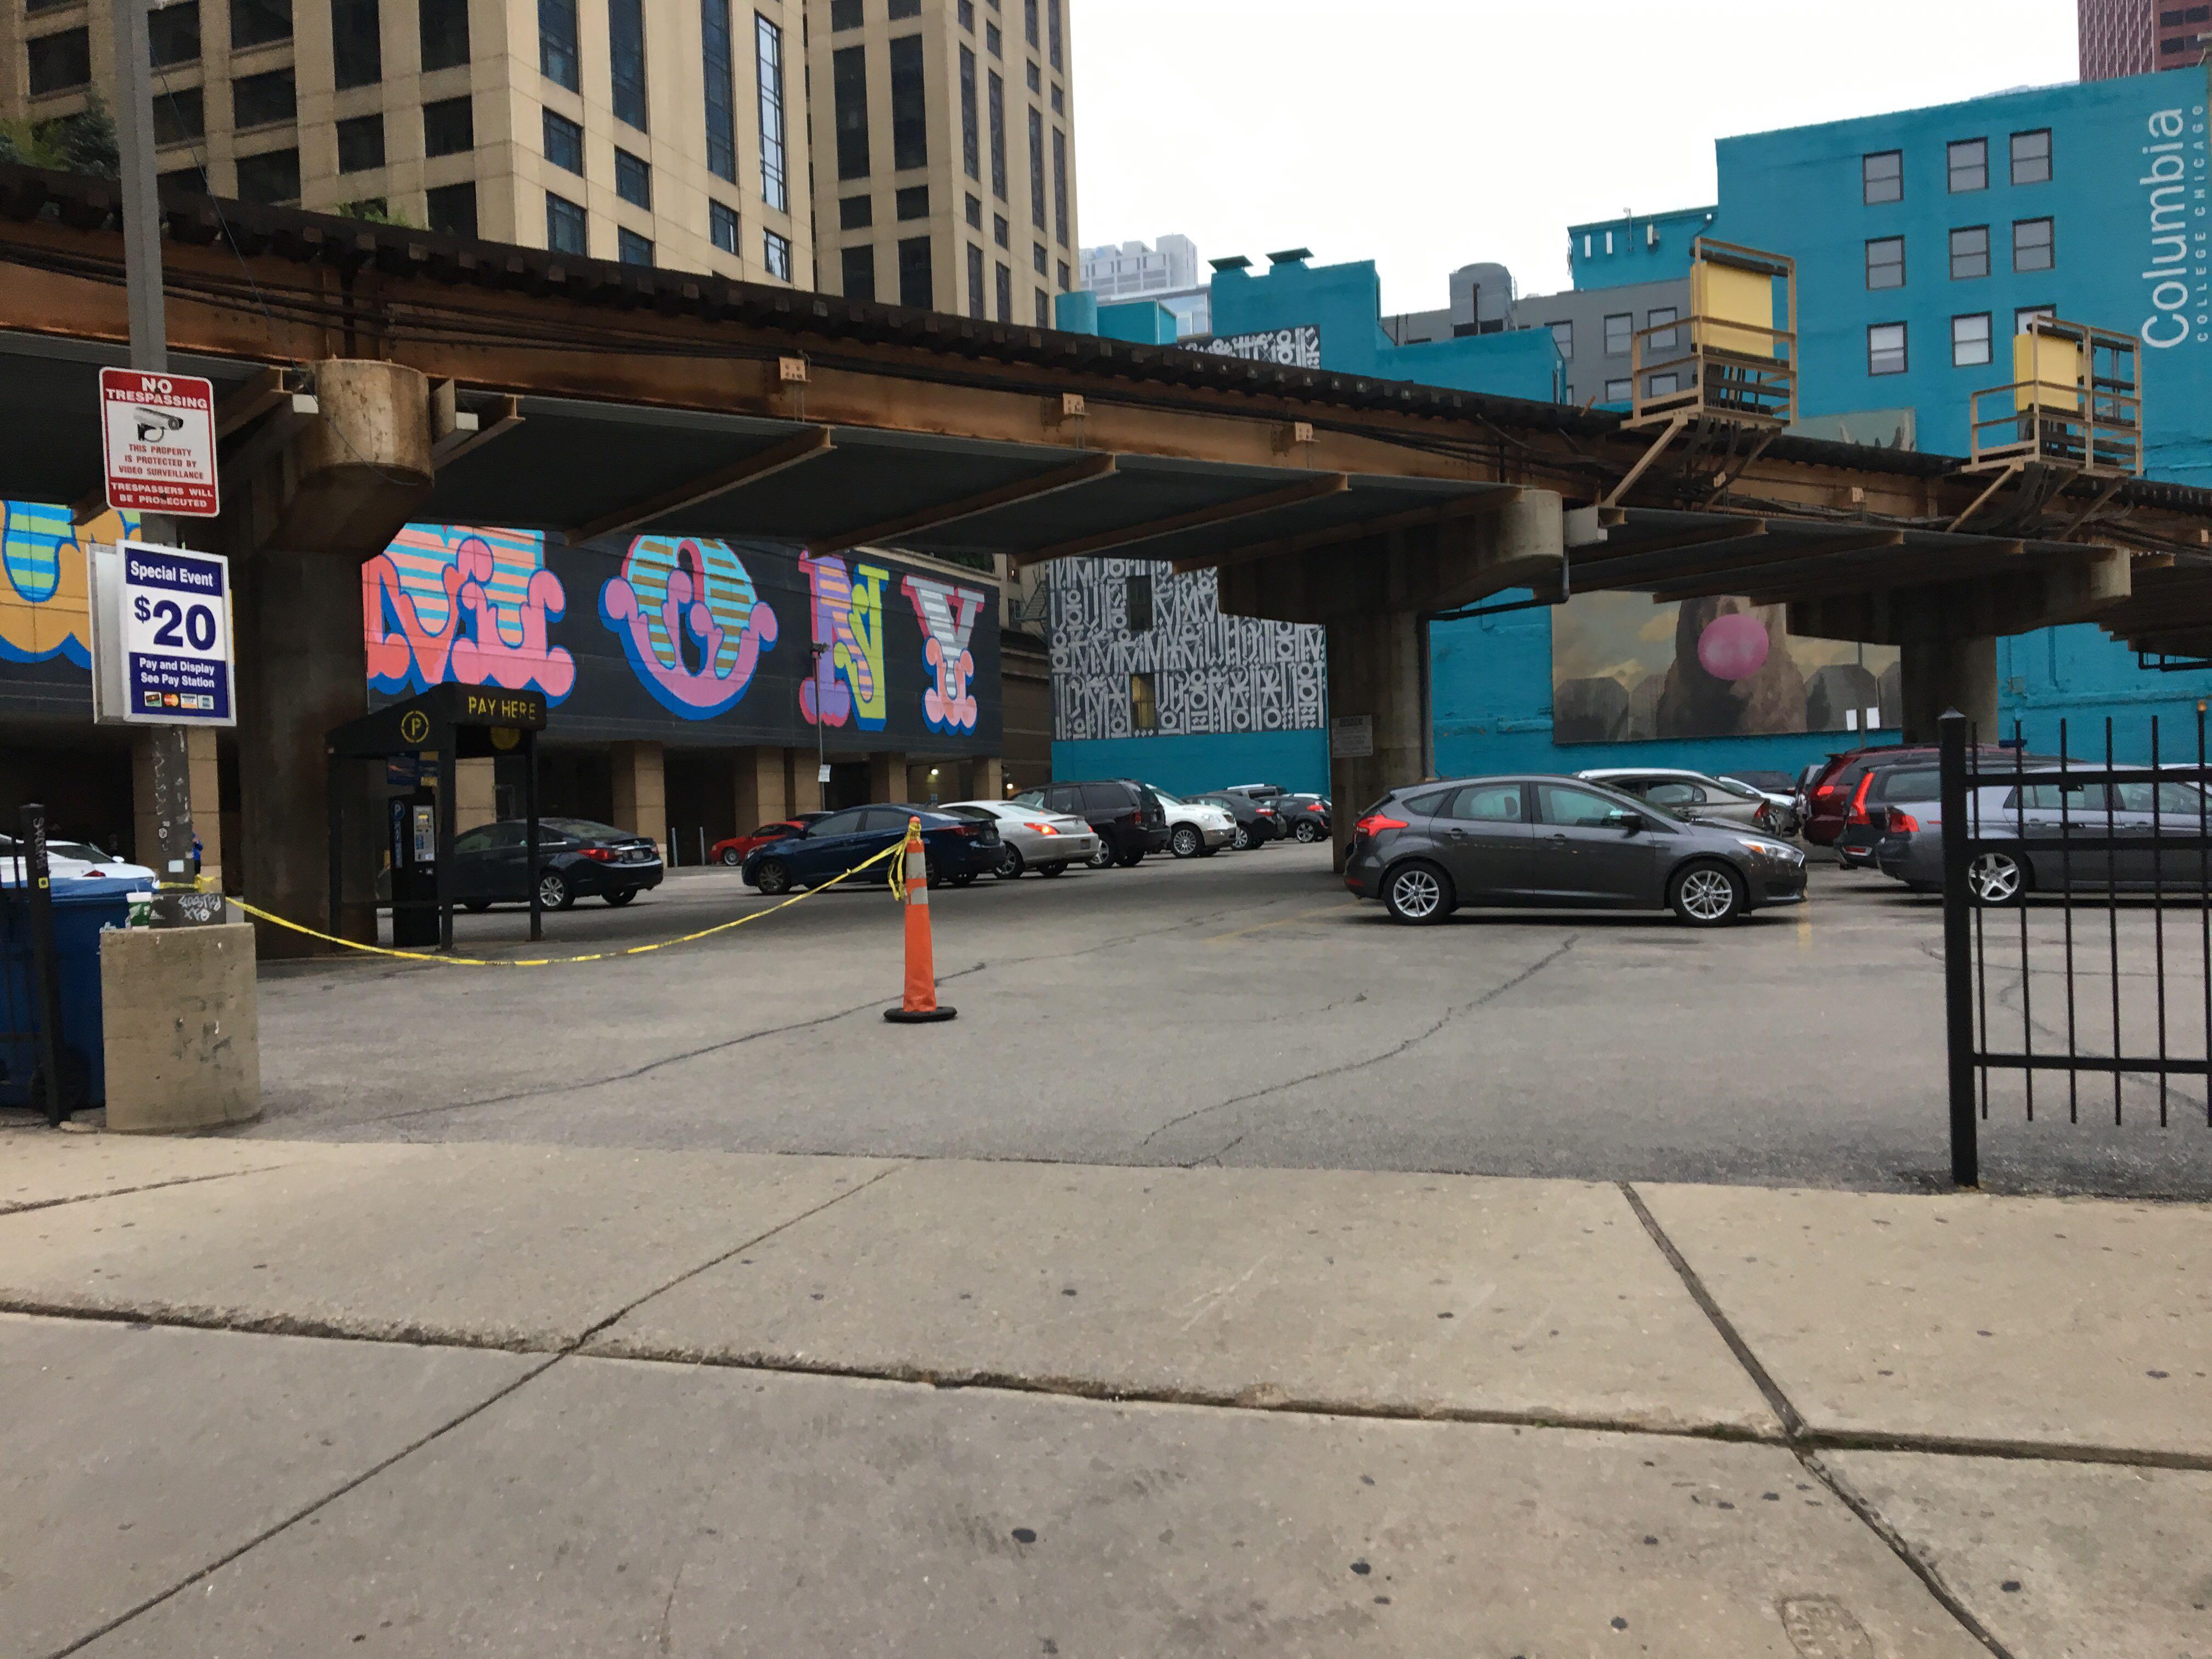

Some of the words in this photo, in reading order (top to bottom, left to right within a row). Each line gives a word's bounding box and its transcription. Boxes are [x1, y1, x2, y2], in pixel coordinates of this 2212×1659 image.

[2192, 105, 2206, 216] CHICAGO
[2140, 108, 2190, 348] Columbia
[2194, 232, 2208, 342] COLLEGE
[142, 377, 172, 393] NO
[105, 388, 207, 409] TRESPASSING
[128, 443, 146, 452] THIS
[151, 446, 191, 456] PROPERTY
[125, 454, 132, 462] IS
[136, 455, 183, 467] PROTECTED
[119, 465, 143, 475] VIDEO
[146, 469, 204, 479] SURVEILLANCE
[110, 482, 184, 495] TRESPASSERS
[189, 488, 213, 498] WILL
[119, 493, 133, 503] BE
[139, 495, 207, 508] PROSECUTED
[130, 560, 176, 582] Special
[180, 568, 213, 587] Event
[134, 595, 216, 651] $20
[139, 657, 156, 672] Pay
[160, 659, 177, 671] and
[180, 661, 215, 675] Display
[140, 672, 159, 684] See
[162, 674, 179, 688] Pay
[182, 676, 215, 688] Station
[469, 697, 496, 715] PAY
[501, 700, 536, 720] HERE
[411, 718, 421, 736] P
